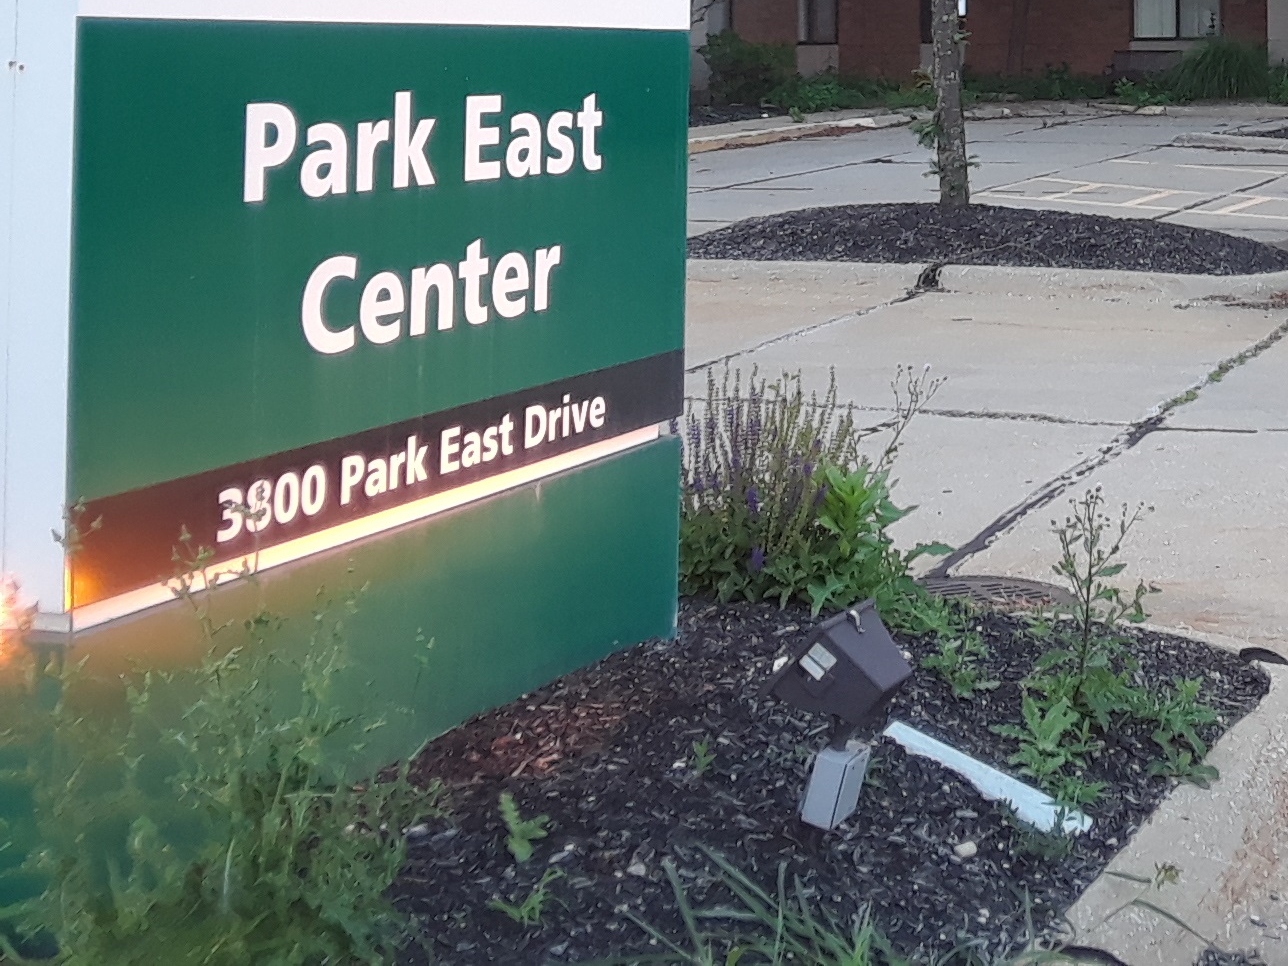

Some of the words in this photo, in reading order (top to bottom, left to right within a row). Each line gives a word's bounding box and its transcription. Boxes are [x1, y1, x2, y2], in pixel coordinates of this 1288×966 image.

[242, 90, 437, 204] Park
[463, 92, 604, 183] East
[300, 238, 562, 356] Center
[216, 464, 327, 543] 3800
[340, 437, 428, 506] Park
[440, 412, 516, 476] East
[523, 392, 607, 450] Drive
